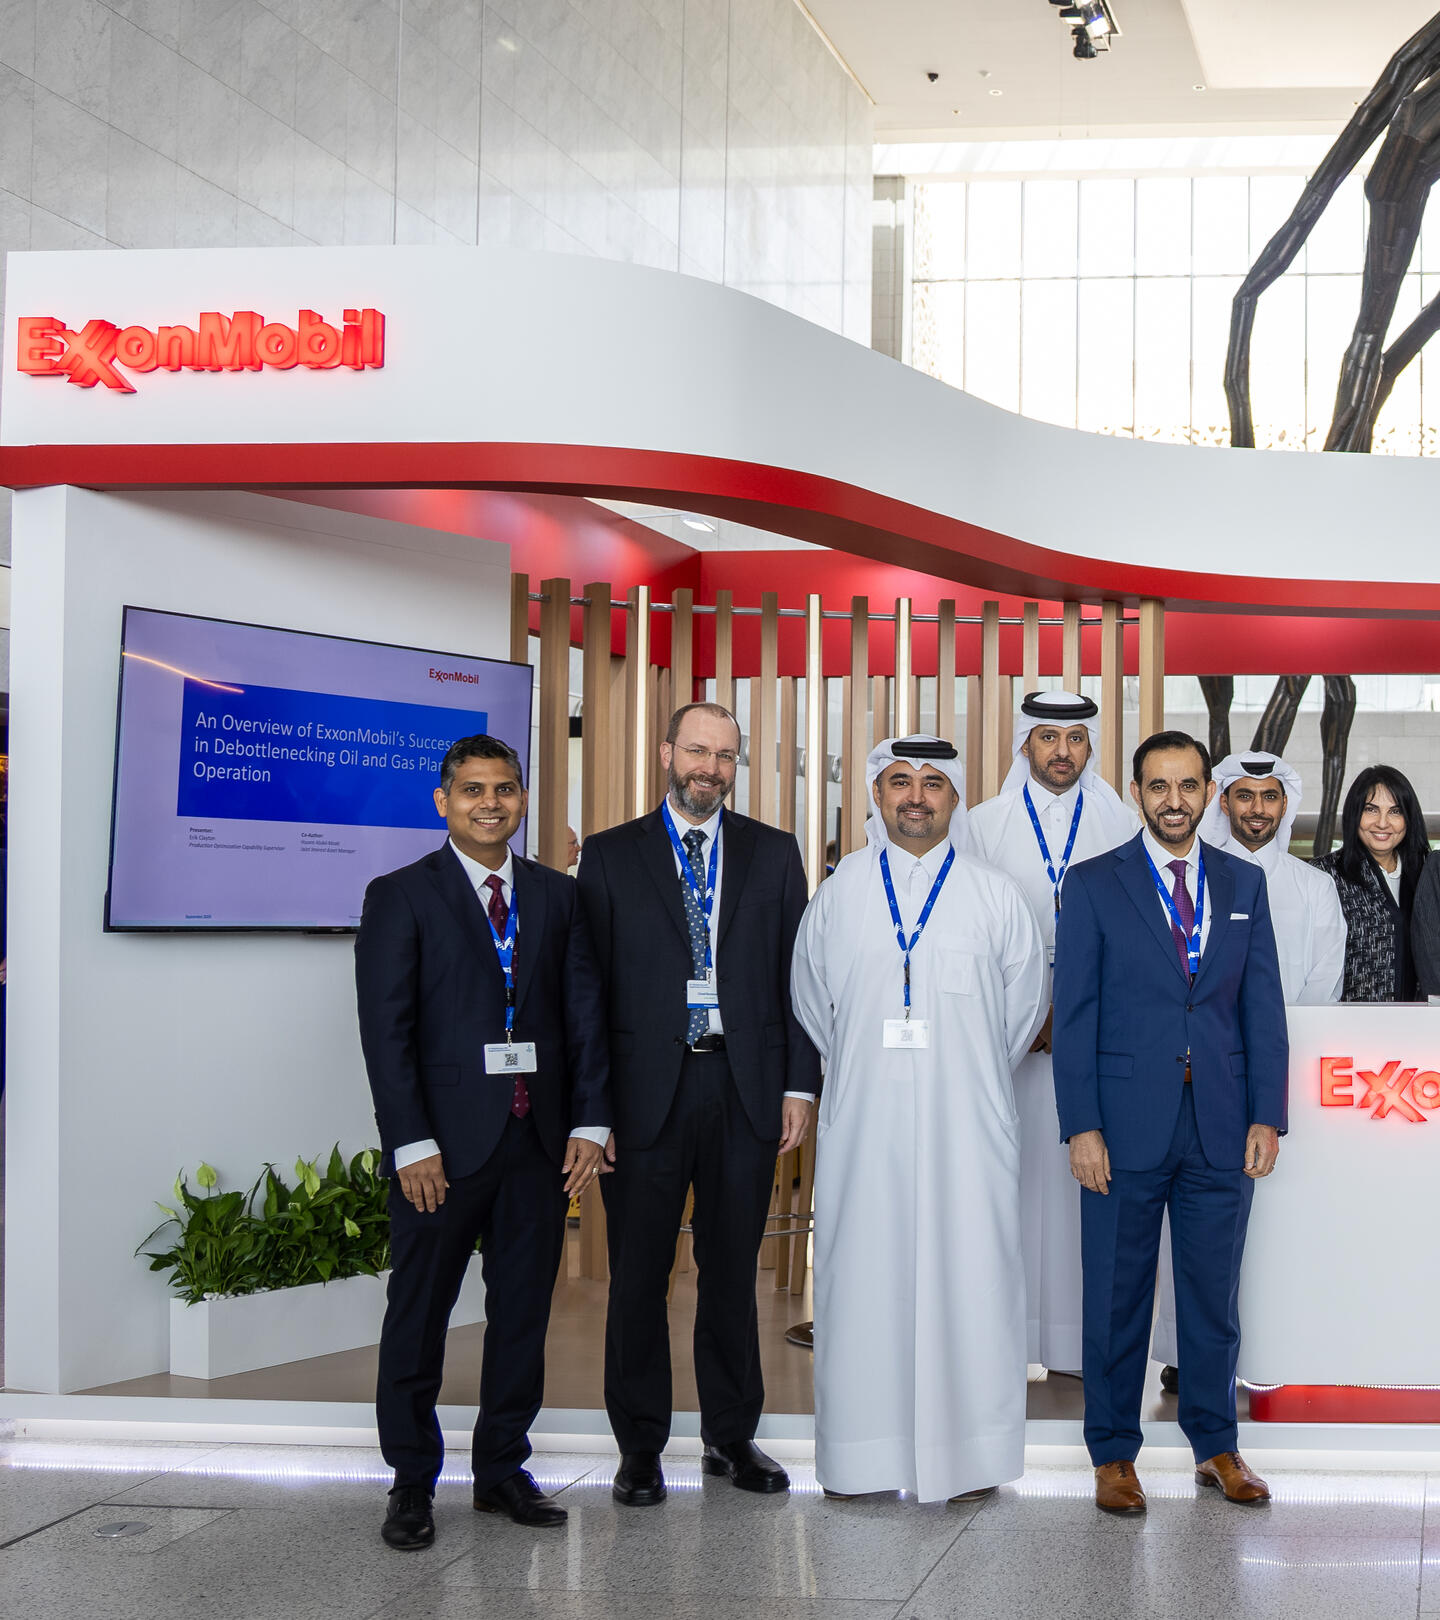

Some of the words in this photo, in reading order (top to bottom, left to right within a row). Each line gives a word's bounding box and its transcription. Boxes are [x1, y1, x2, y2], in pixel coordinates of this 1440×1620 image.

[17, 308, 386, 393] ExxonMobil
[429, 668, 479, 684] ExxonMobil
[195, 711, 217, 729] An
[222, 714, 293, 737] Overview
[297, 722, 313, 738] of
[316, 724, 405, 748] ExxonMobil's
[195, 736, 209, 753] in
[214, 738, 335, 768] Debottlenecking
[339, 749, 358, 766] Oil
[362, 753, 387, 769] and
[391, 754, 415, 771] Gas
[193, 761, 271, 783] Operation
